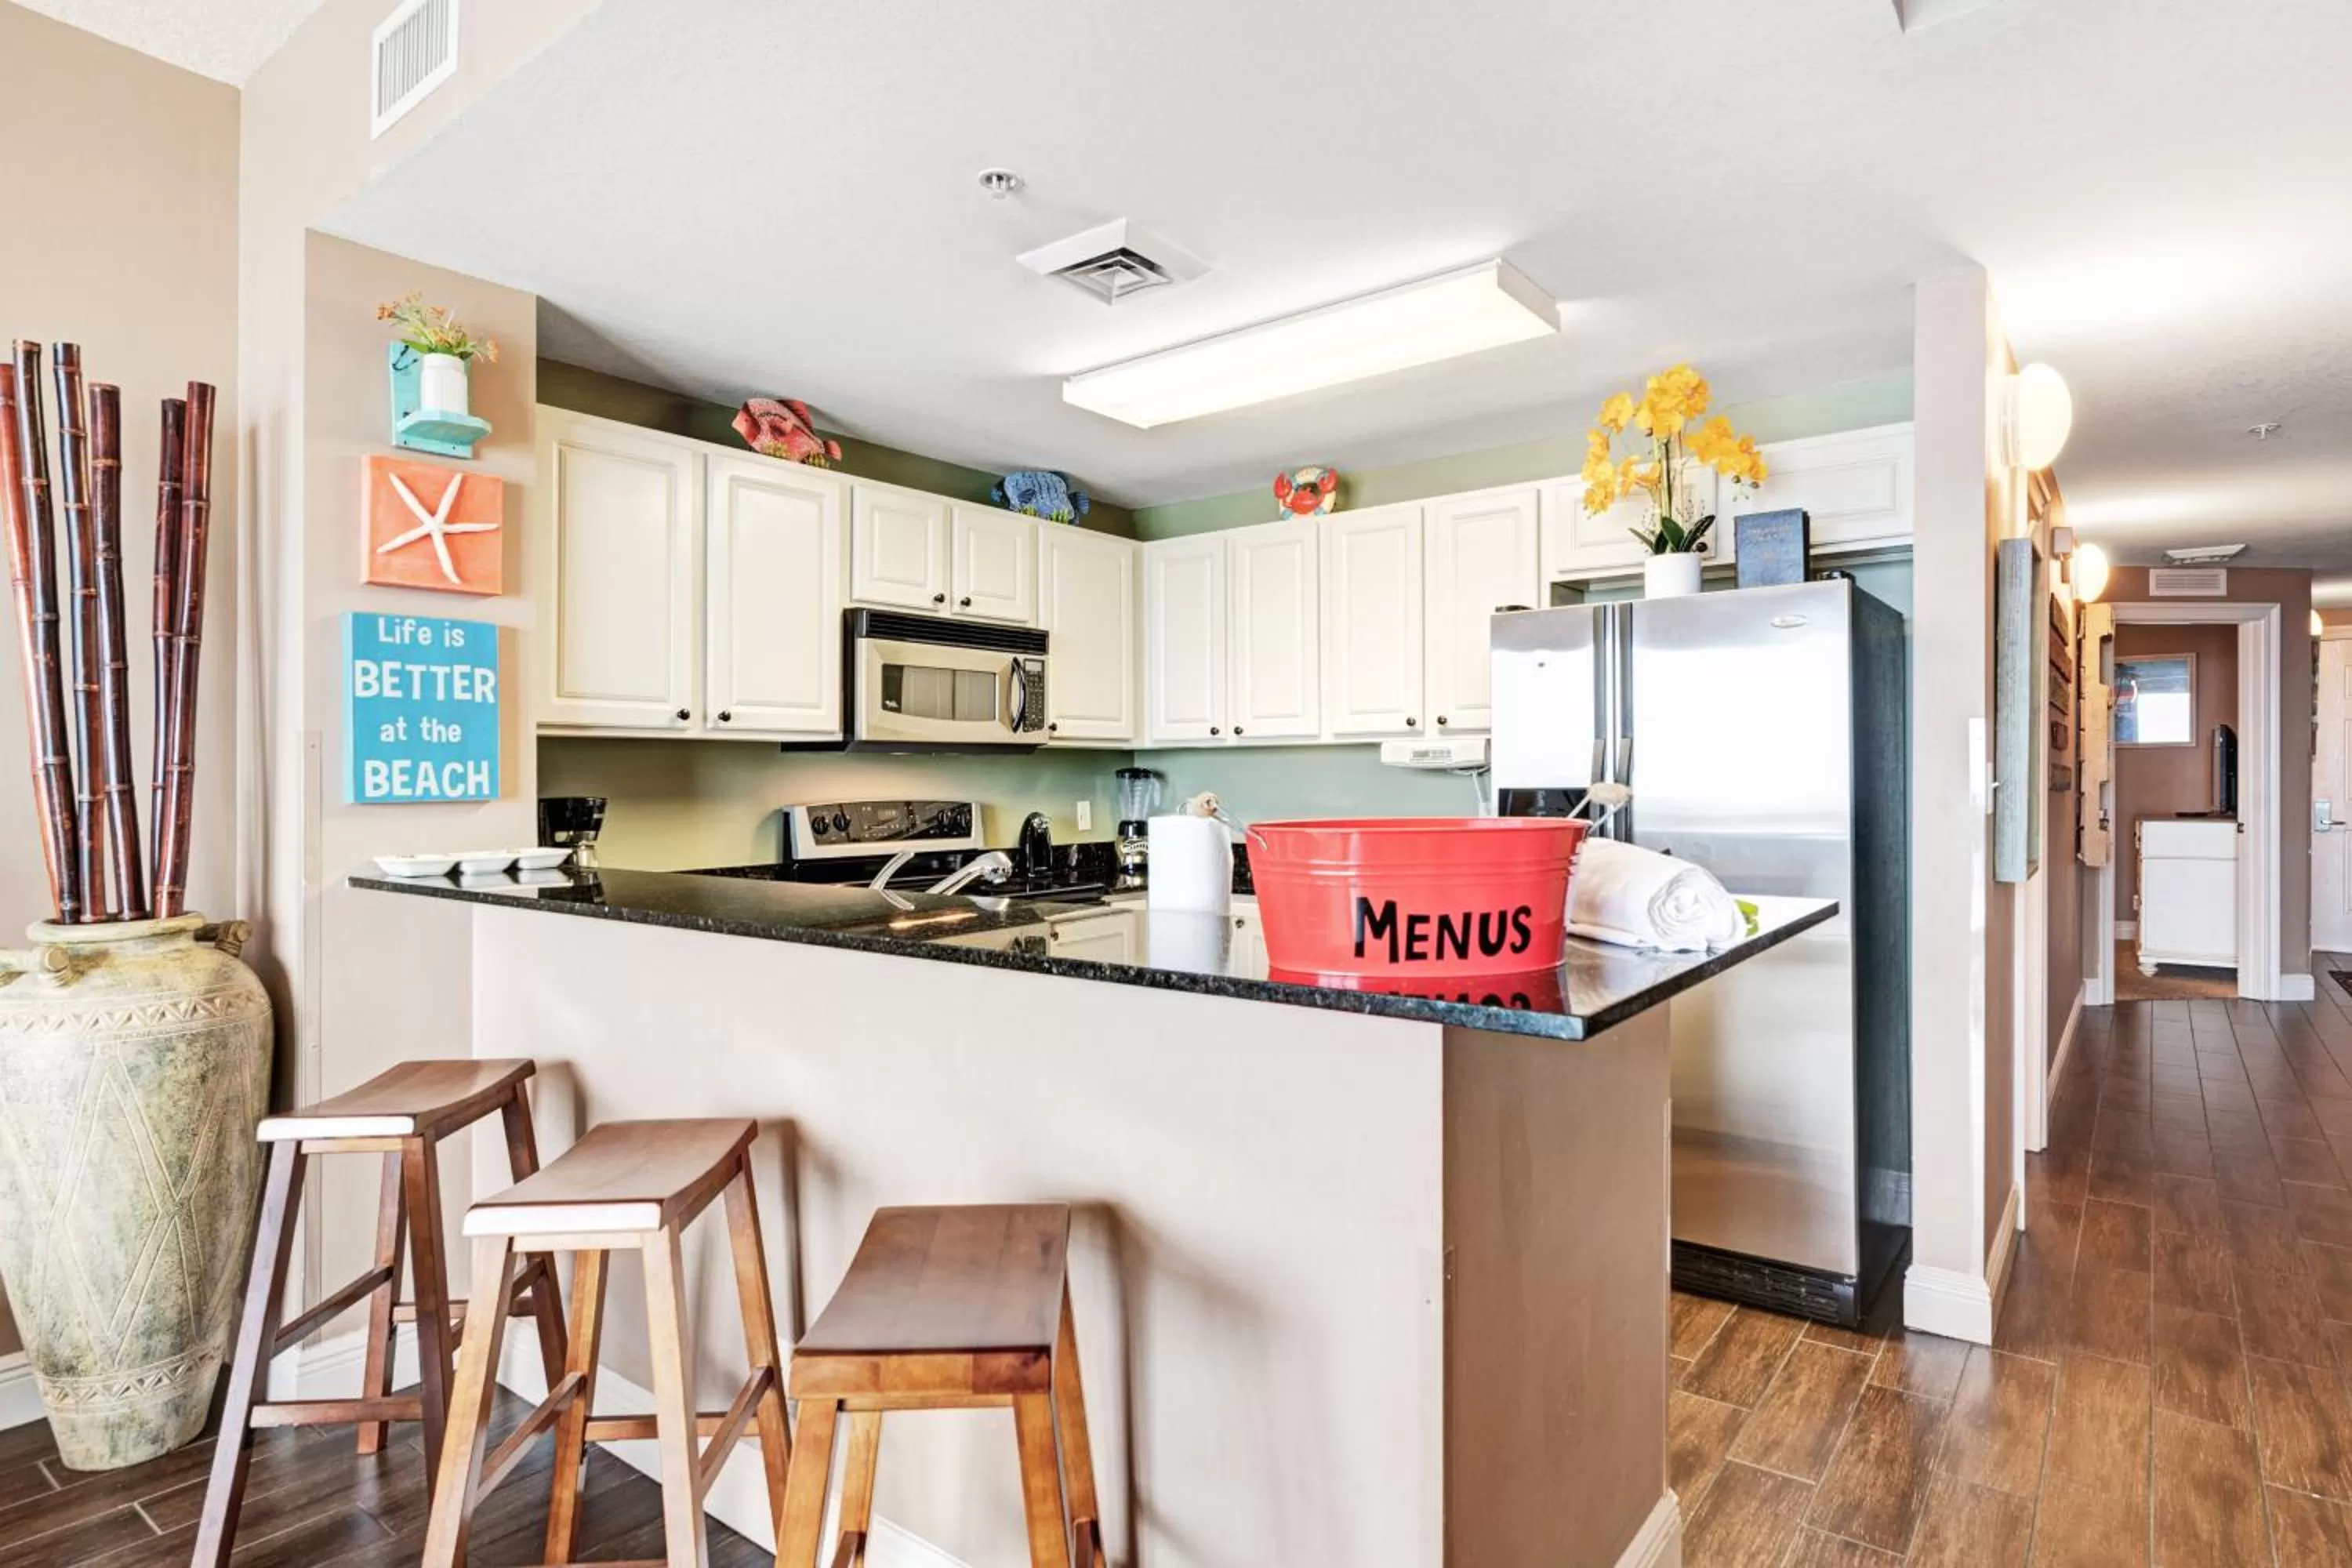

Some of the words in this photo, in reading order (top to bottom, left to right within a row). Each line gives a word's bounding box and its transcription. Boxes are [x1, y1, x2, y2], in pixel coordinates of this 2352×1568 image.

[378, 617, 432, 645] Life
[444, 622, 464, 648] is
[354, 659, 496, 704] BETTER
[379, 715, 407, 742] at
[420, 716, 462, 743] the
[364, 759, 490, 798] BEACH
[1354, 896, 1532, 964] MENUS
